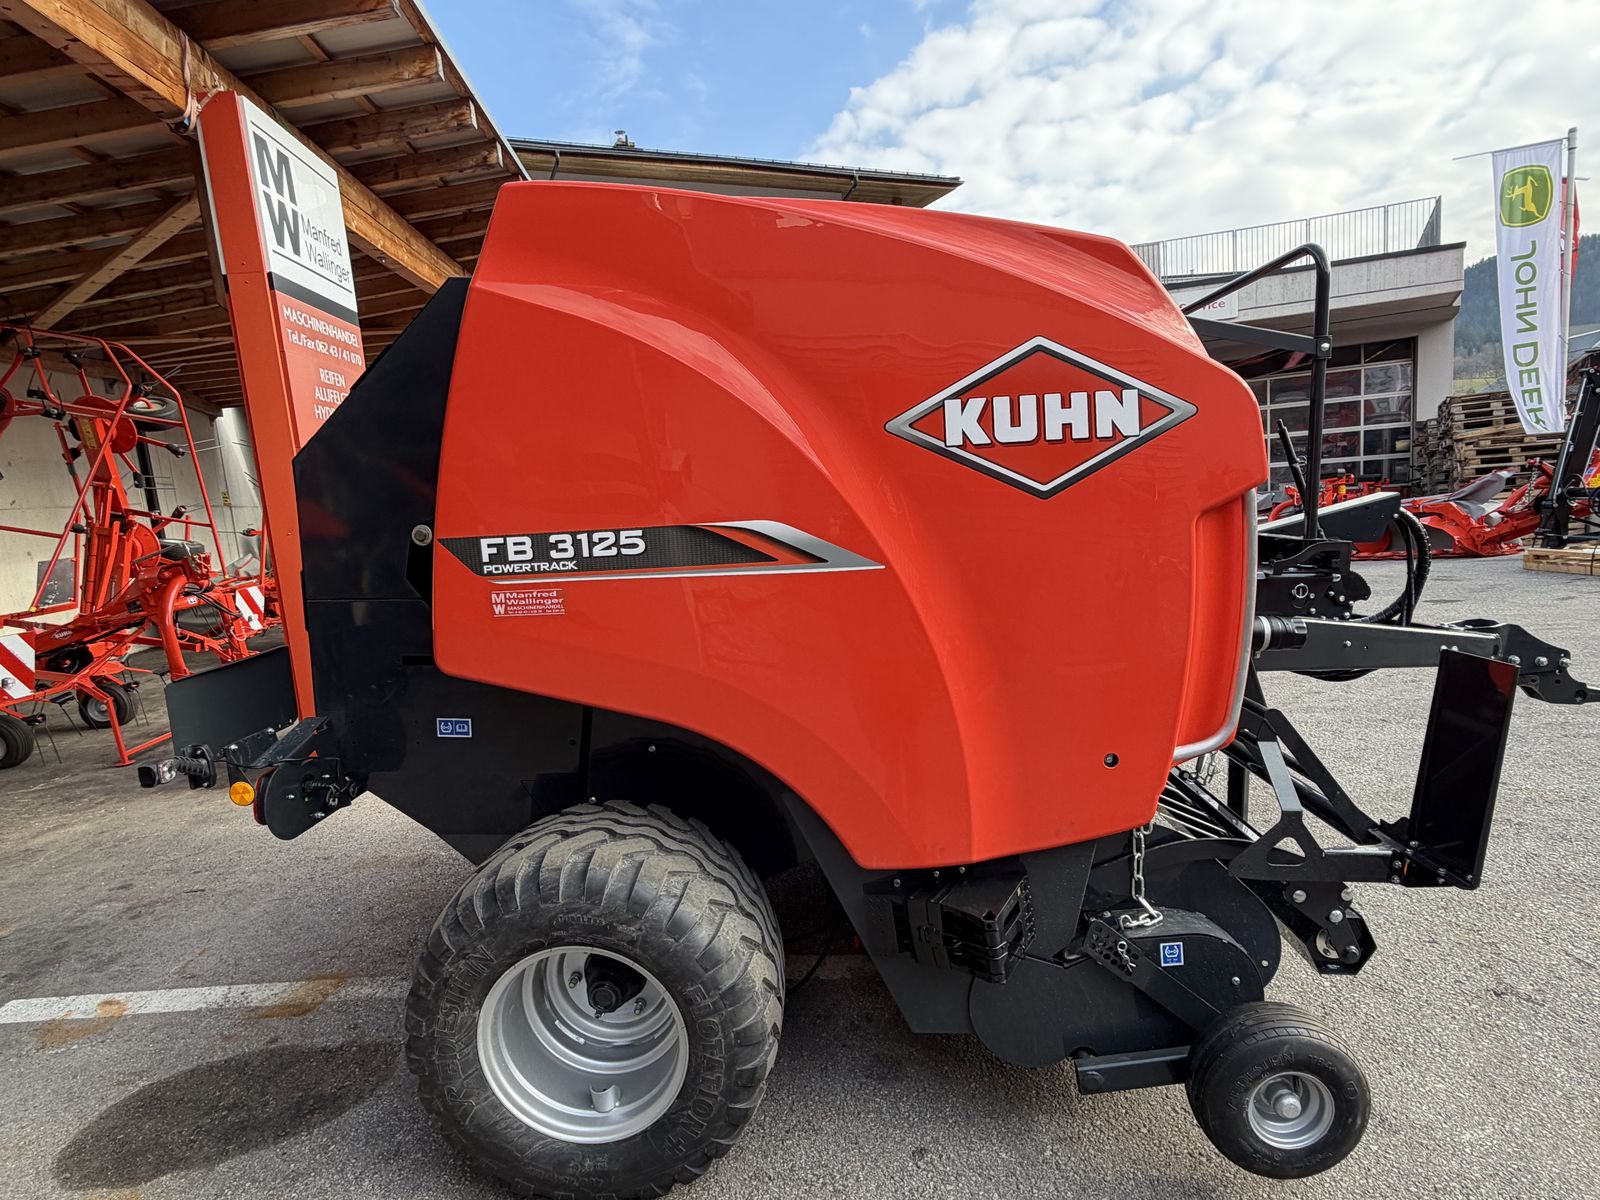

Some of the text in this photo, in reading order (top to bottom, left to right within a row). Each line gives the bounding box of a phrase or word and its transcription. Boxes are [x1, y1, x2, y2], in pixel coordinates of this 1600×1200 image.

[252, 130, 298, 206] M
[263, 189, 301, 258] W
[300, 213, 342, 256] Manfred
[304, 240, 350, 283] Wallinger
[282, 304, 360, 348] MASCHINENHANDEL
[315, 339, 329, 355] 062
[329, 345, 338, 358] 43
[342, 350, 351, 361] 41
[351, 353, 362, 366] 070
[315, 385, 349, 404] ALUFELG
[319, 368, 346, 388] REIFEN
[314, 404, 335, 421] HYD
[944, 389, 1141, 448] KUHN
[480, 530, 647, 563] FB 3125
[483, 560, 578, 575] POWERTRACK
[505, 590, 557, 599] Manfred
